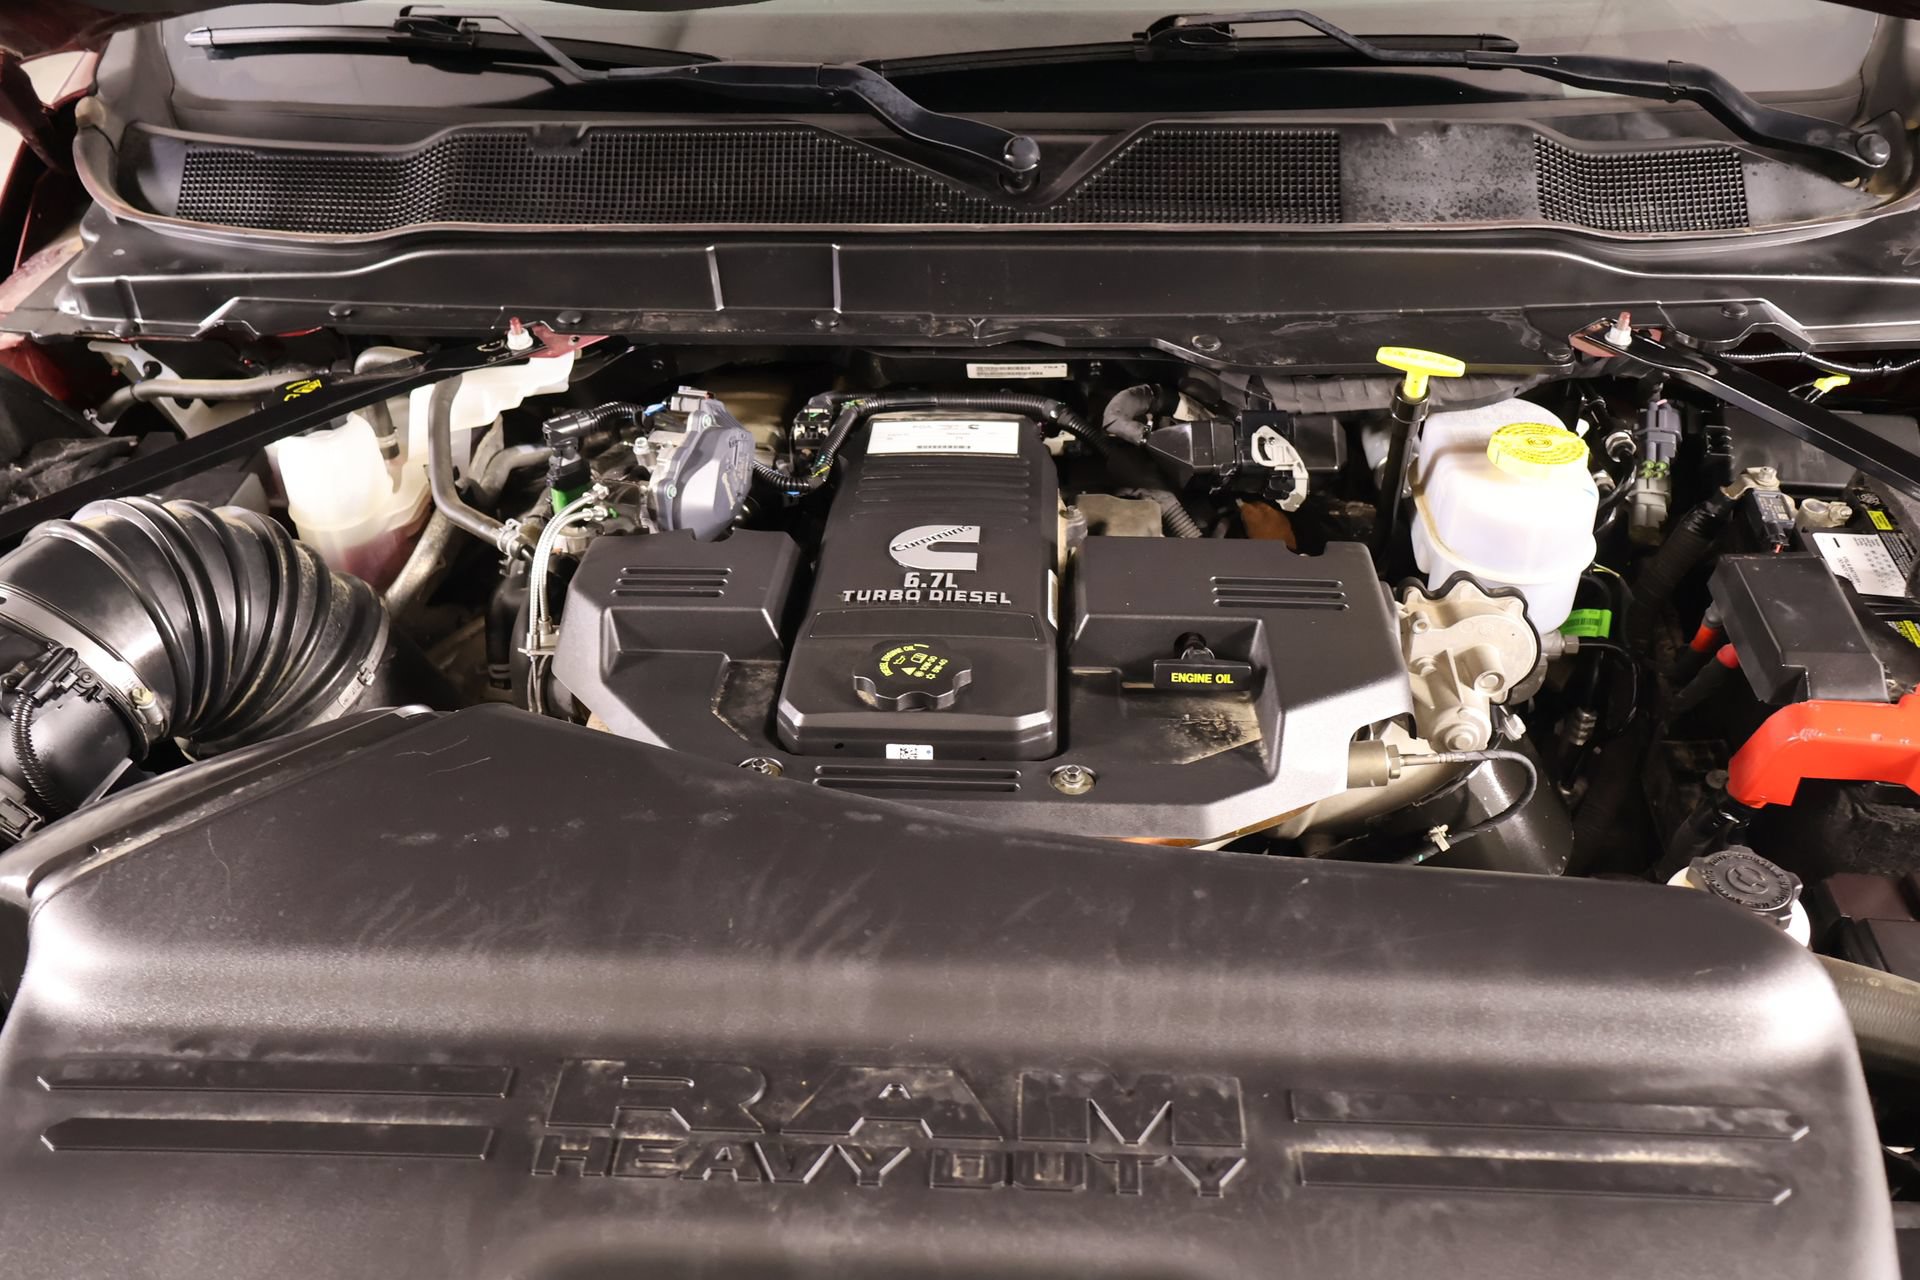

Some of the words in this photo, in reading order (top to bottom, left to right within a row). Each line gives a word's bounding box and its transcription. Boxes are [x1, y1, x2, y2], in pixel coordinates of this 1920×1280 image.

[891, 524, 972, 552] Cummins
[903, 572, 958, 589] 6.7L
[842, 589, 921, 603] TURBO
[929, 589, 1011, 604] DIESEL
[1171, 672, 1213, 684] ENGINE
[1215, 673, 1234, 684] OIL
[545, 1056, 1247, 1149] RAM
[530, 1133, 912, 1188] HEAVY
[928, 1146, 1247, 1198] DUTY
